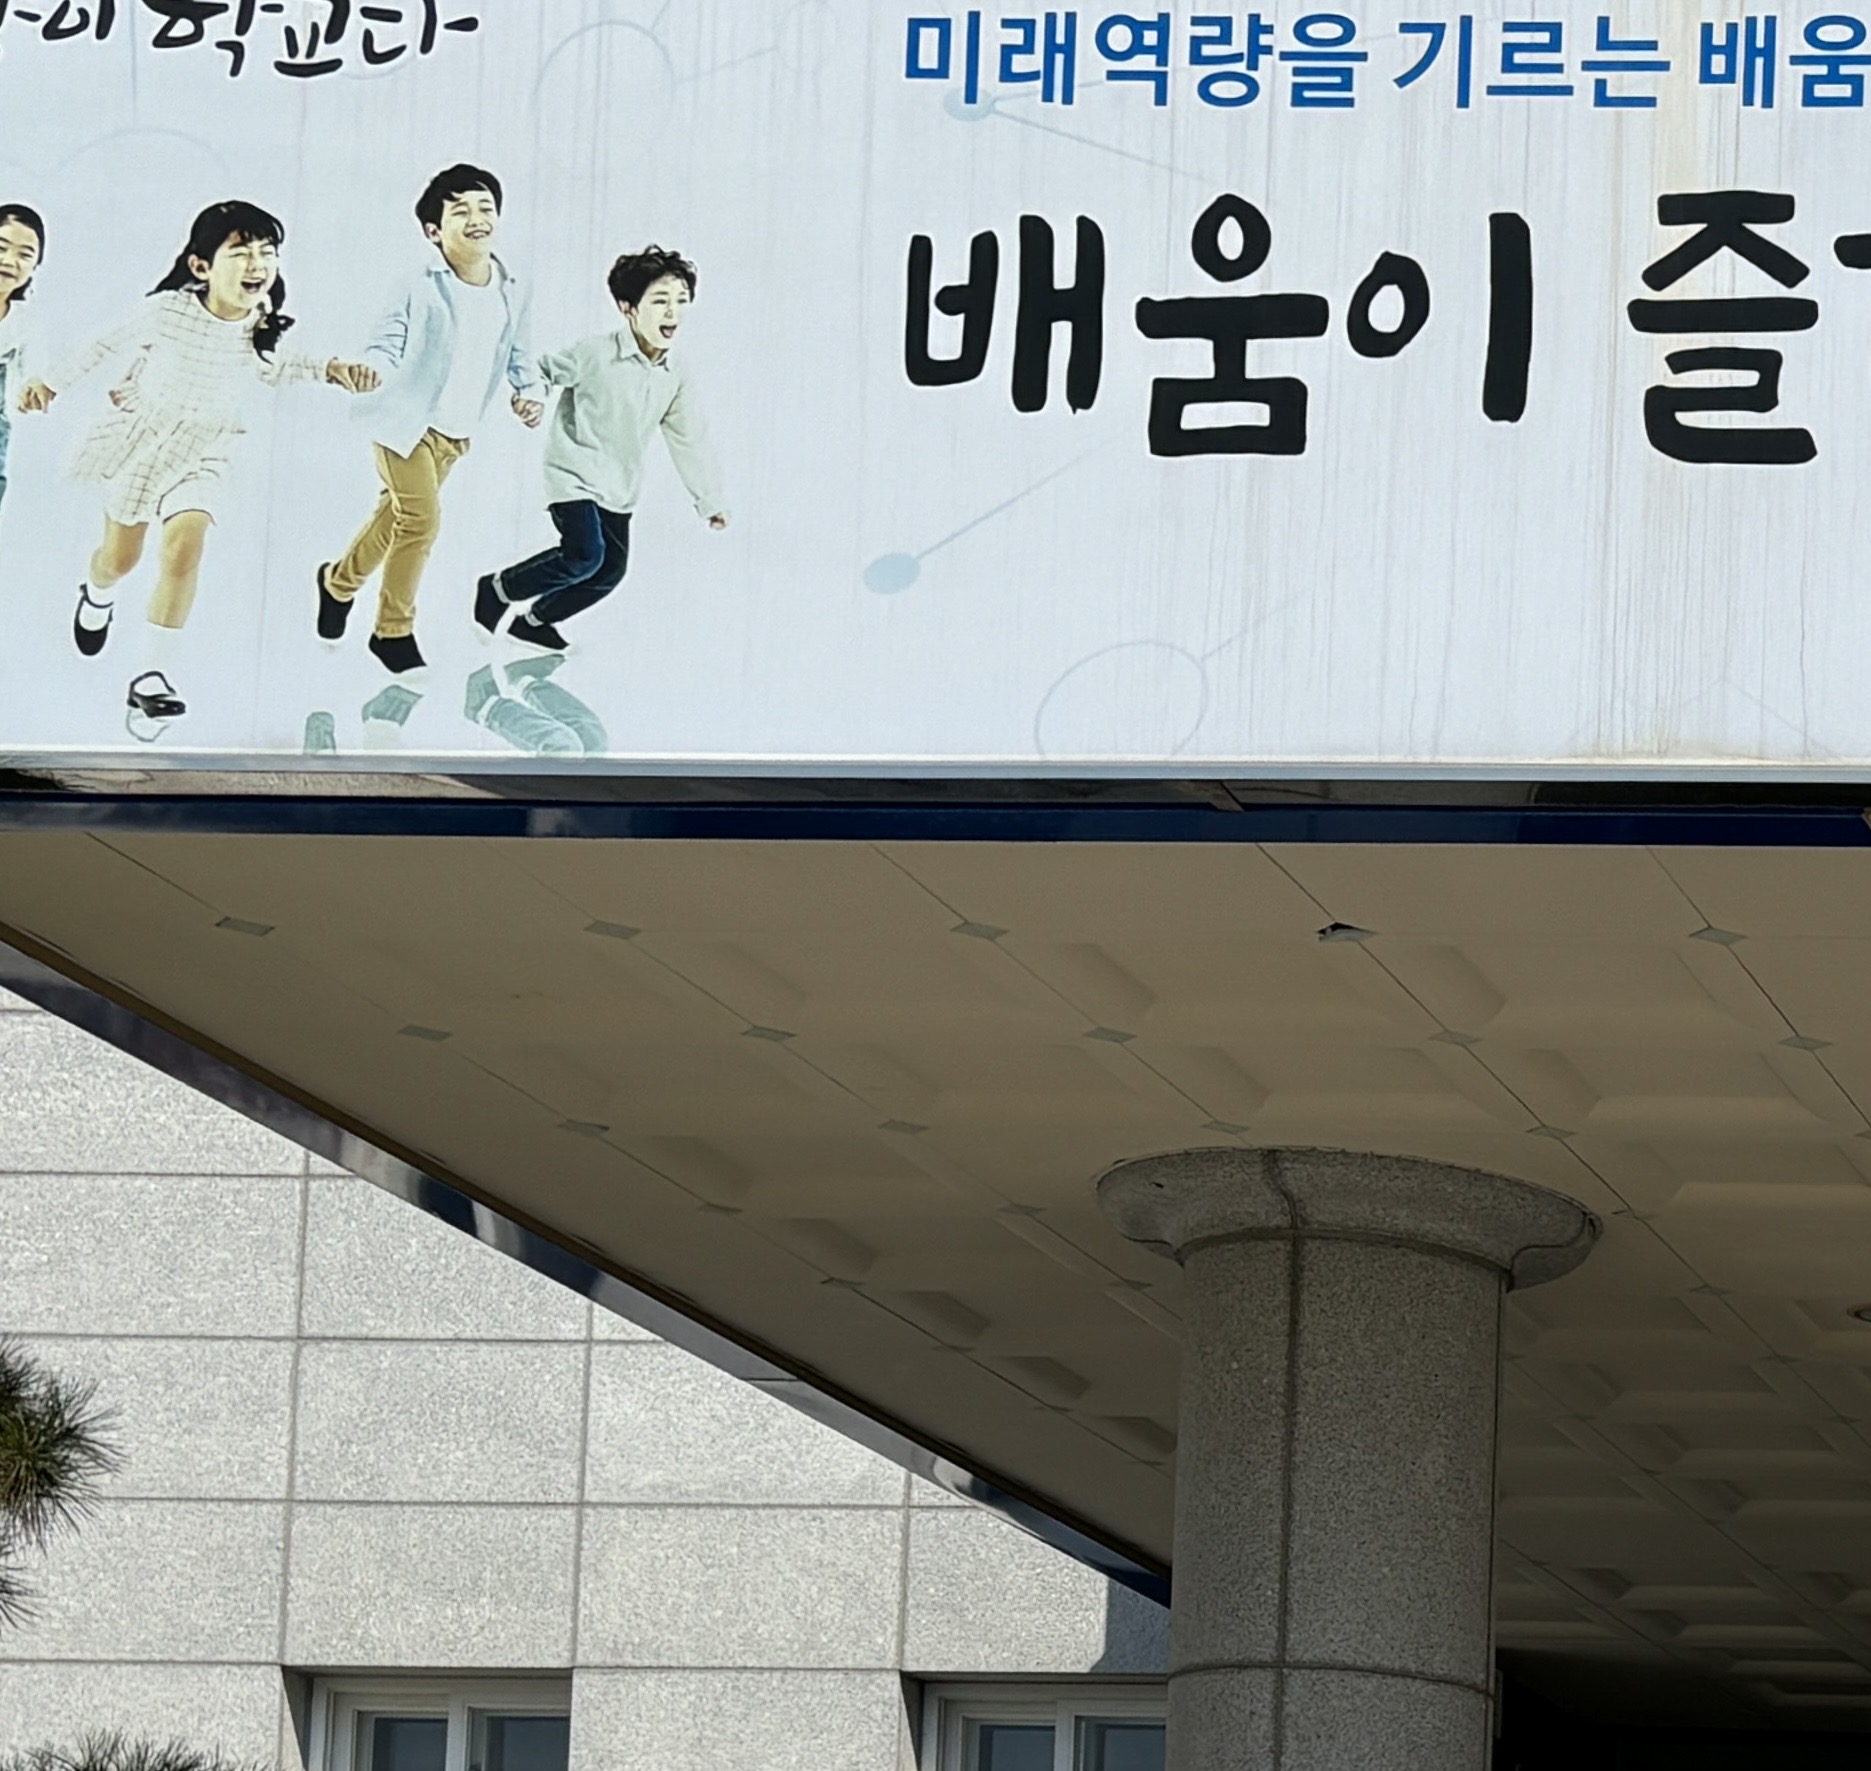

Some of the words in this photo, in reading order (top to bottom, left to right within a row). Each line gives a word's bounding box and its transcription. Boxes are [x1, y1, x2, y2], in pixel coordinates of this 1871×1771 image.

[0, 0, 115, 40] 이
[905, 12, 1368, 108] 미래역량을
[1393, 14, 1670, 108] 기르는
[905, 194, 1532, 456] 배움이
